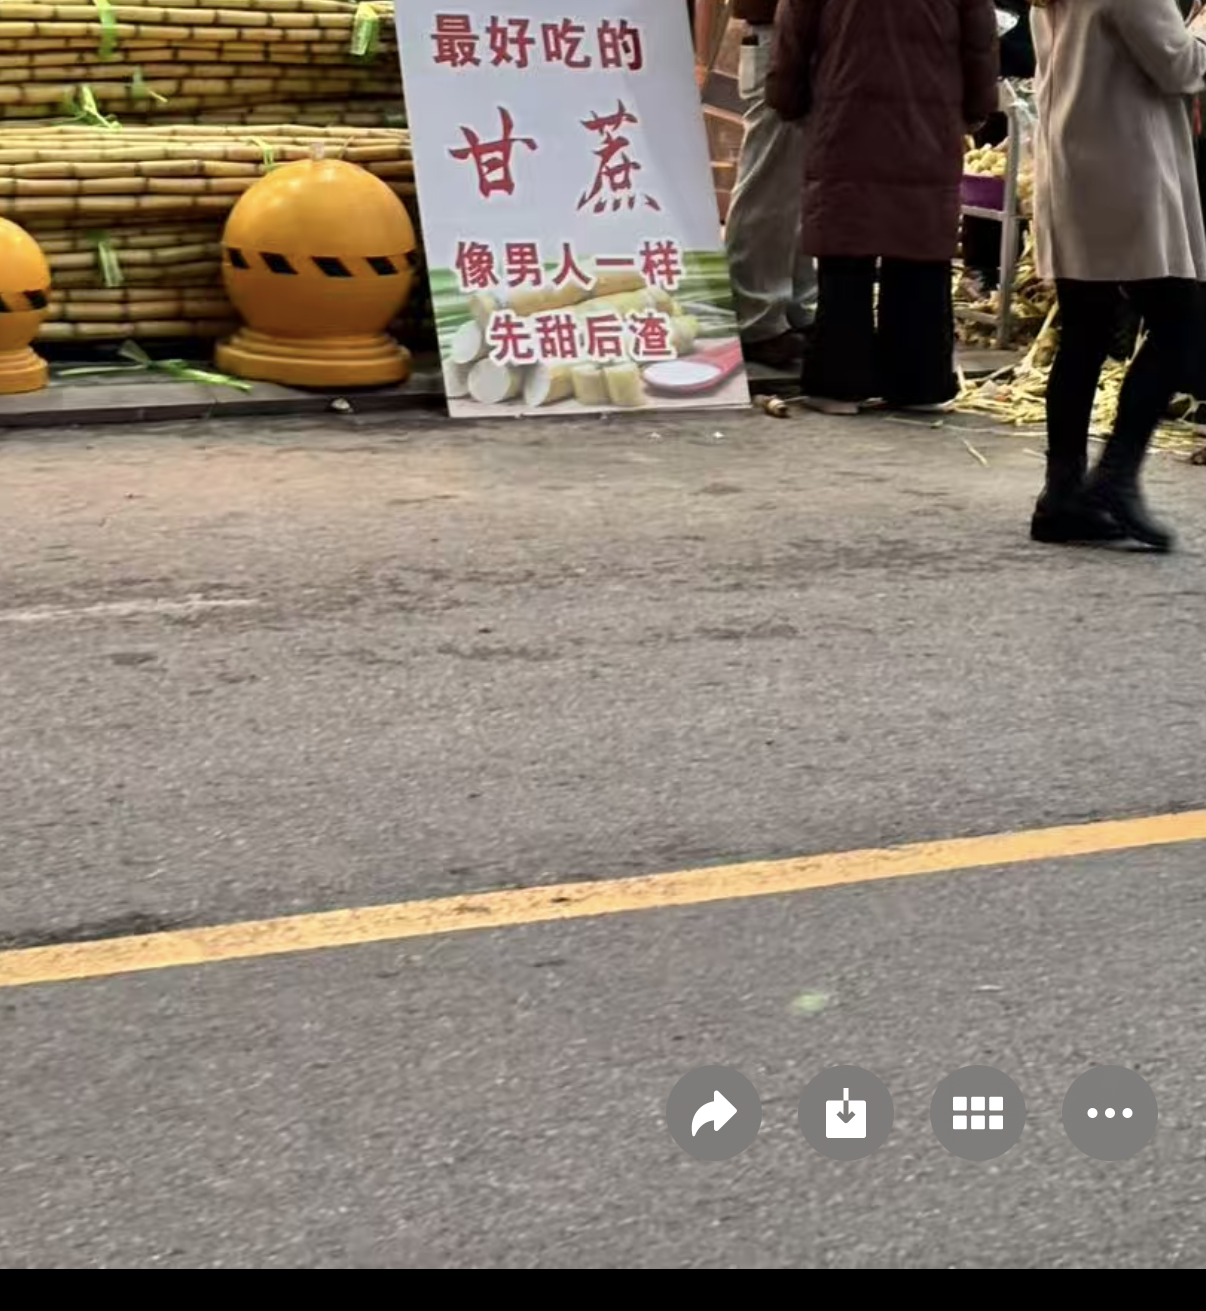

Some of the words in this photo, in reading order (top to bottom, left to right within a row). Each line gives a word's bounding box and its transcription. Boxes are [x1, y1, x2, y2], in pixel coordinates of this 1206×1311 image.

[430, 13, 644, 71] 最好吃的
[448, 98, 661, 214] 甘蔗
[455, 241, 683, 289] 像男人一样
[489, 312, 673, 362] 先甜后渣
